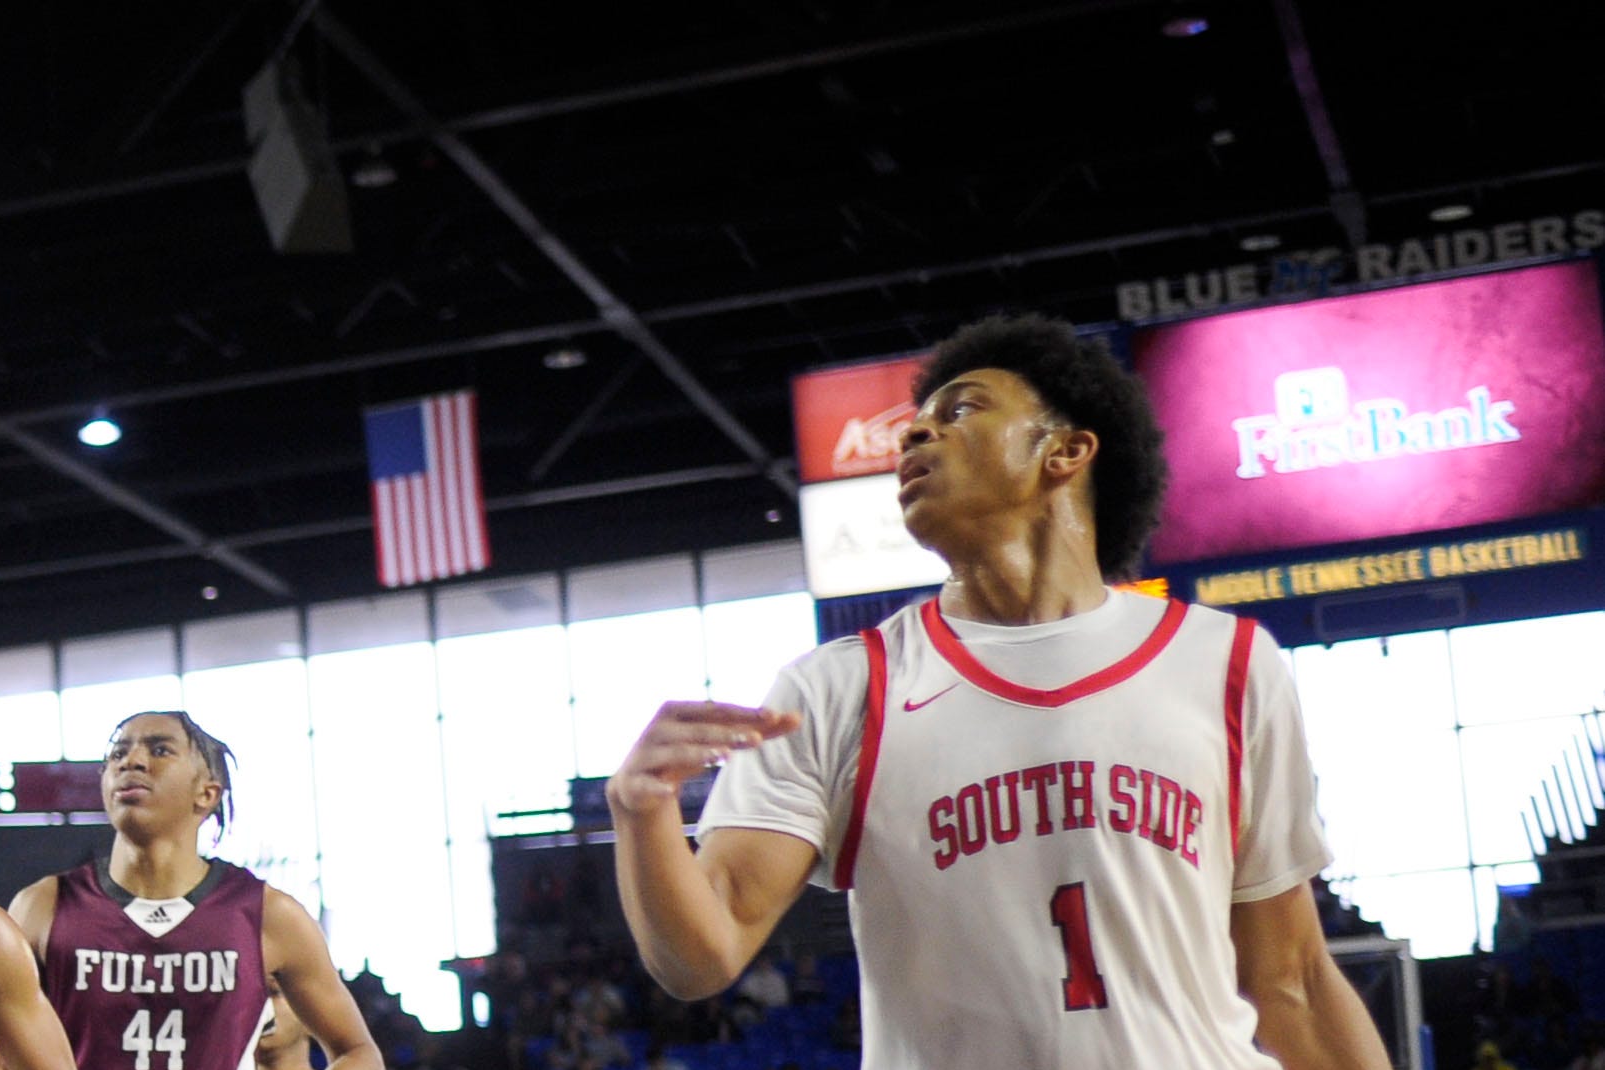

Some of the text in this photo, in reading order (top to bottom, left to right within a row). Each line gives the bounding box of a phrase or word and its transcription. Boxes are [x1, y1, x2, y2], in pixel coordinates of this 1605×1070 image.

[1116, 264, 1261, 322] BLUE
[1357, 210, 1605, 283] RAIDERS
[1232, 385, 1521, 479] FirstBank
[1195, 529, 1583, 606] MIDDLE TENNESSEE BASKETBALL
[928, 760, 1204, 871] SOUTH SIDE
[75, 949, 239, 993] FULTON
[1050, 881, 1109, 1012] 1
